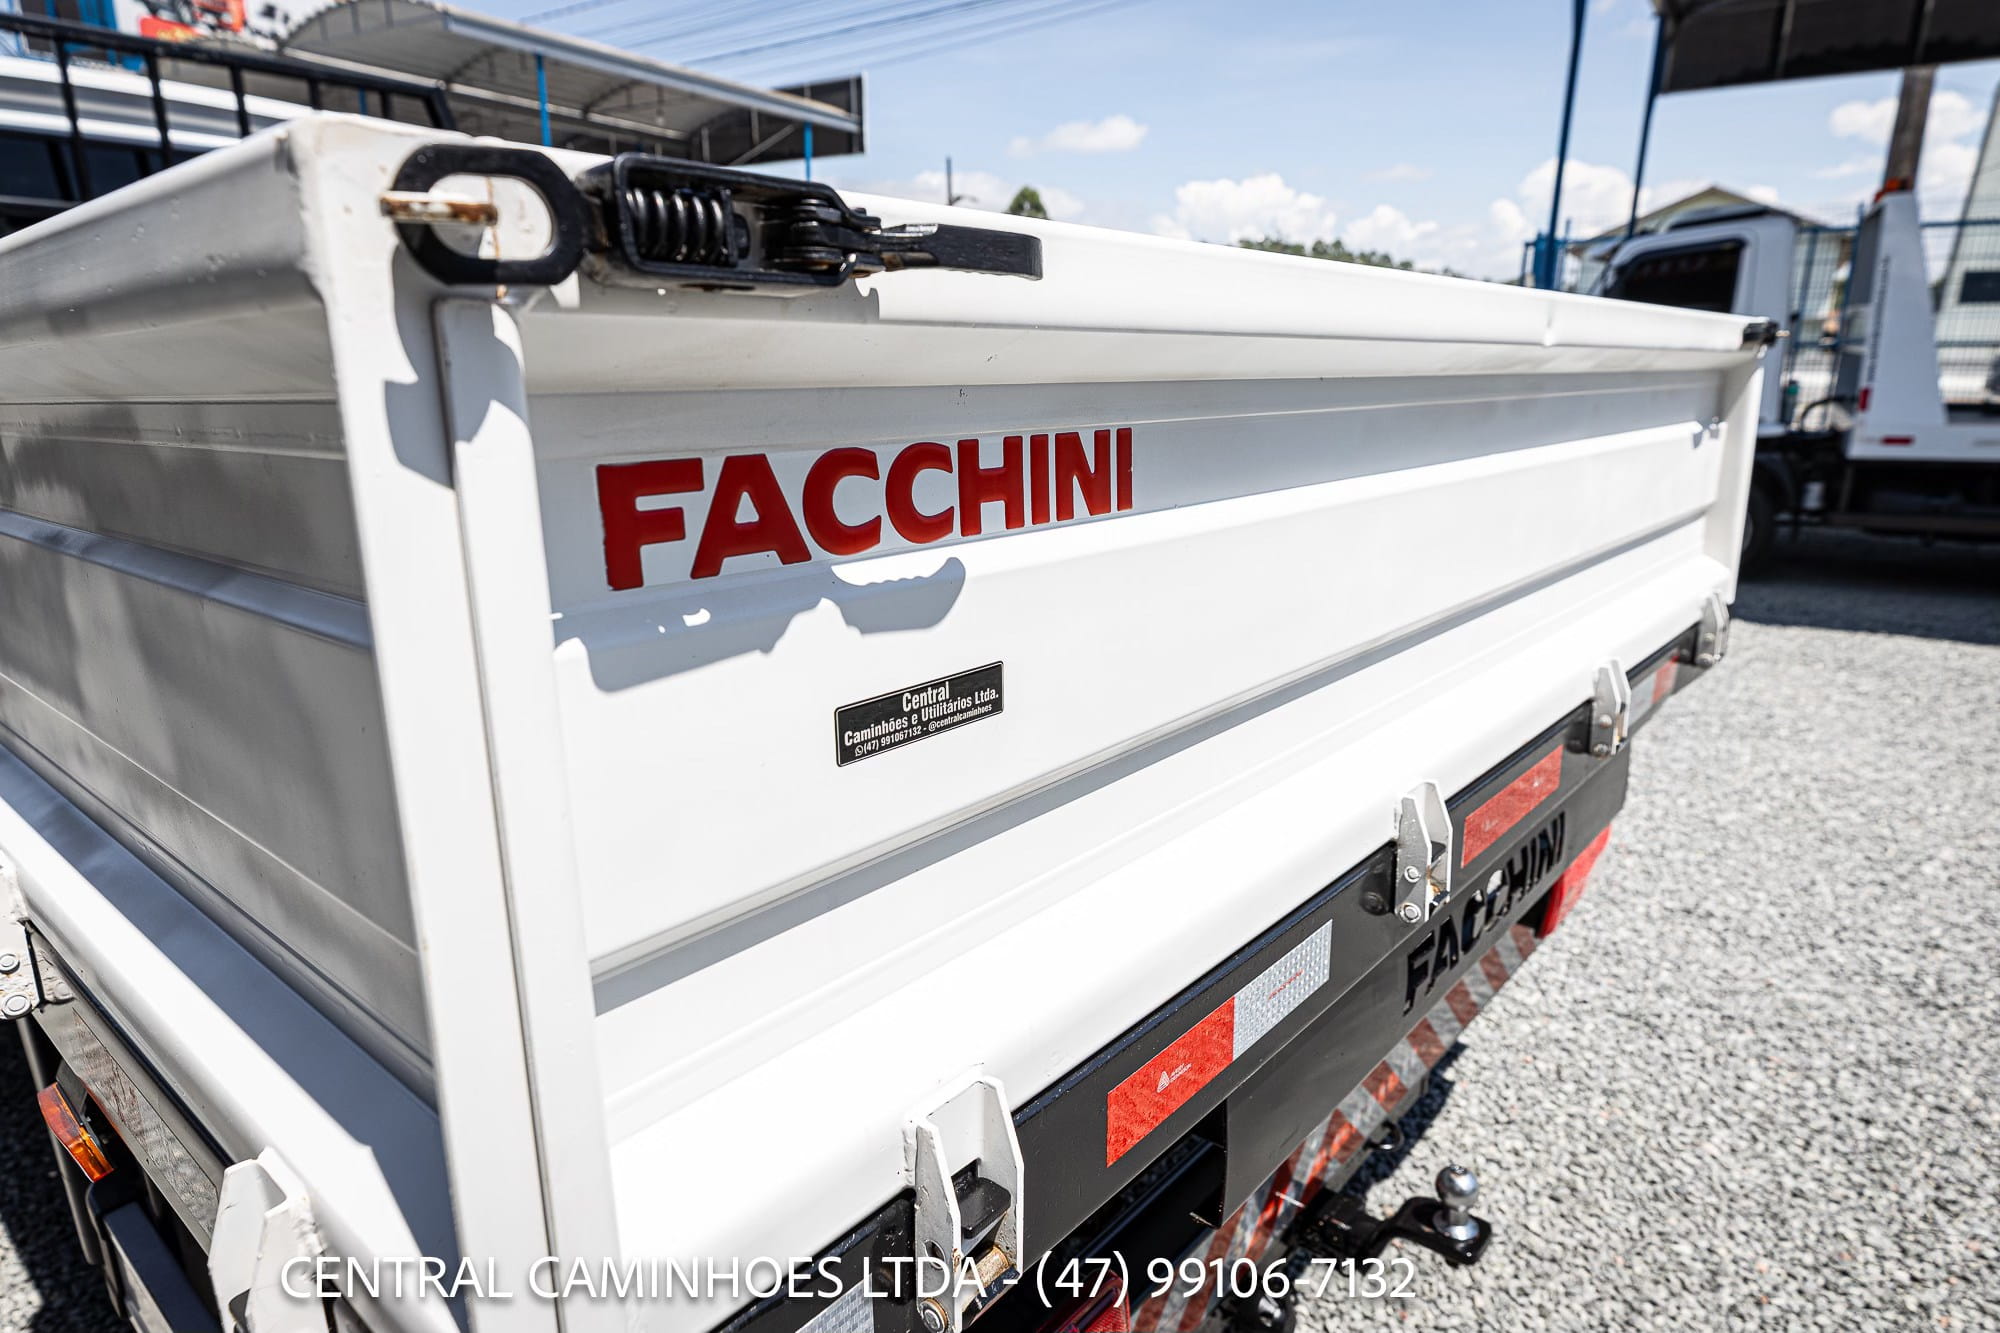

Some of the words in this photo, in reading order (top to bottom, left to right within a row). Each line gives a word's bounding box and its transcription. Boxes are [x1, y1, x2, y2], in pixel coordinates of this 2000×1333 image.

[596, 427, 1133, 591] FACCHINI
[844, 717, 908, 746] Caminhões
[911, 713, 918, 725] e
[921, 696, 972, 722] Utilitários
[974, 688, 999, 705] Ltda.
[903, 681, 950, 712] Central
[863, 739, 879, 755] (47)
[880, 725, 922, 747] 991067132
[928, 703, 993, 732] @centralcaminhoes
[1403, 811, 1566, 1007] FACCHINI
